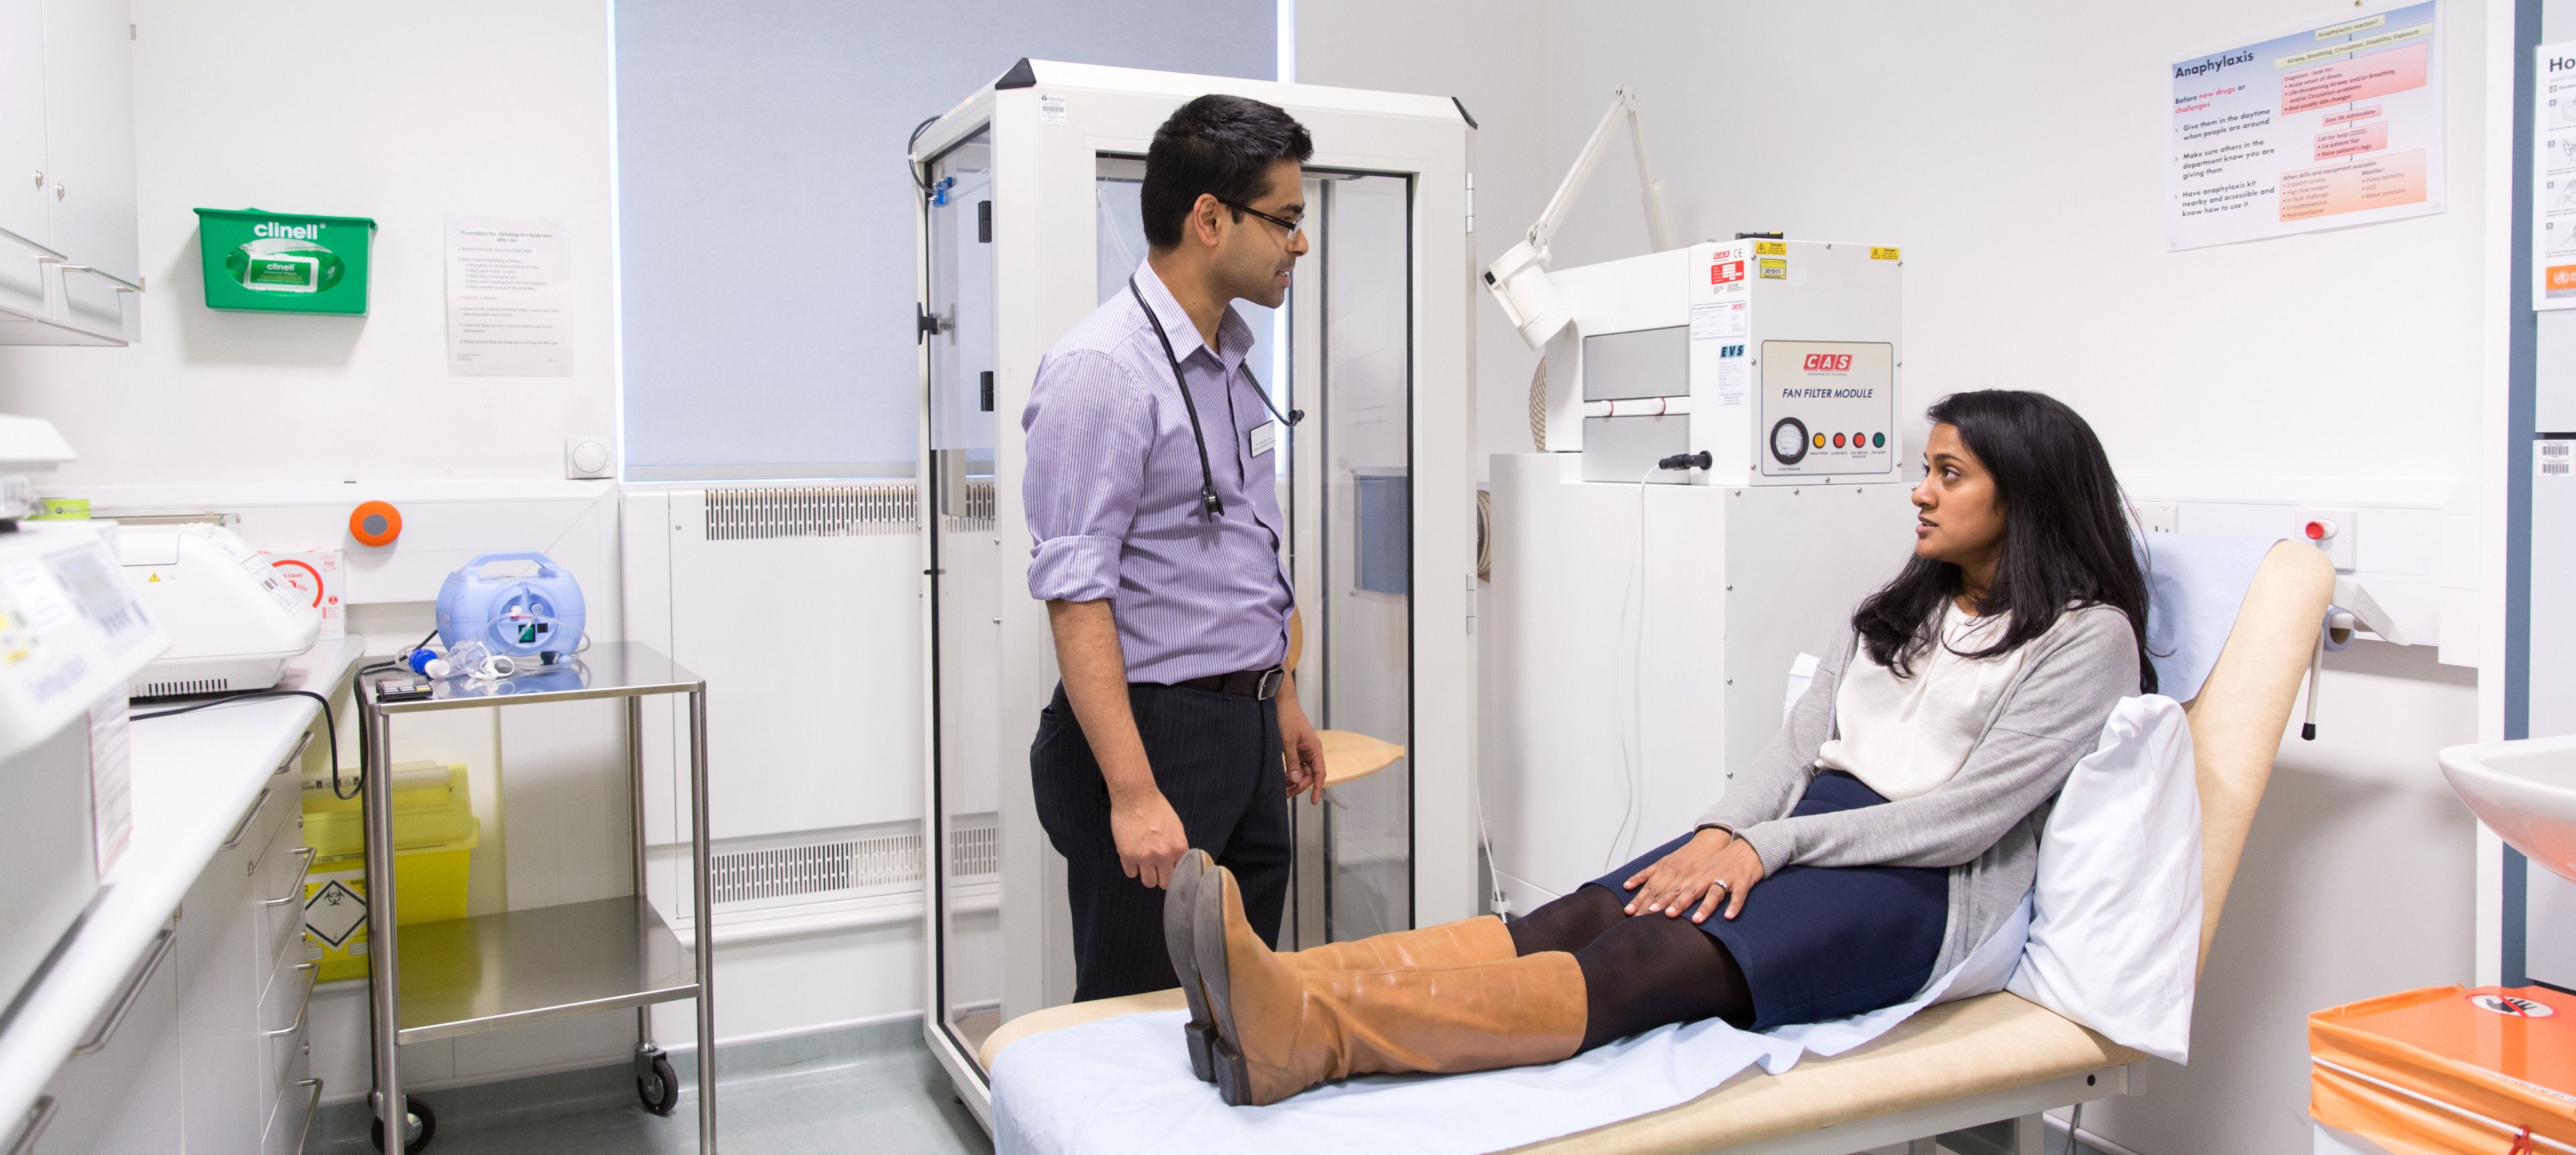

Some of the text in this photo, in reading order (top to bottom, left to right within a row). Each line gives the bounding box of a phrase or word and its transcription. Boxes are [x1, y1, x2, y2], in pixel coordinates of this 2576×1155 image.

[2175, 51, 2254, 79] Anaphylaxis
[2369, 70, 2395, 79] Breathing
[2175, 95, 2197, 104] Before
[2199, 91, 2214, 99] new
[2216, 86, 2236, 97] drugs
[2308, 90, 2336, 99] Circulation
[2337, 85, 2361, 94] problems
[2175, 102, 2210, 114] challenges
[2346, 110, 2375, 118] Adrenaline
[2183, 122, 2199, 131] Give
[2201, 120, 2217, 128] them
[2240, 109, 2270, 120] daytime
[2184, 132, 2202, 140] when
[2203, 127, 2227, 138] people
[2330, 140, 2349, 148] patient
[2183, 152, 2202, 160] Make
[2220, 144, 2242, 153] others
[2183, 157, 2222, 169] department
[2224, 154, 2244, 162] know
[2246, 150, 2260, 159] you
[2182, 170, 2204, 181] giving
[2324, 165, 2352, 174] equipment
[2182, 190, 2201, 198] Have
[2203, 182, 2245, 195] anaphylaxis
[2182, 187, 2274, 207] nearby and accessible and
[2182, 208, 2202, 217] know
[1720, 344, 1744, 357] EVS
[1805, 355, 1851, 369] CAS
[1782, 389, 1873, 398] FAN FILTER MODULE
